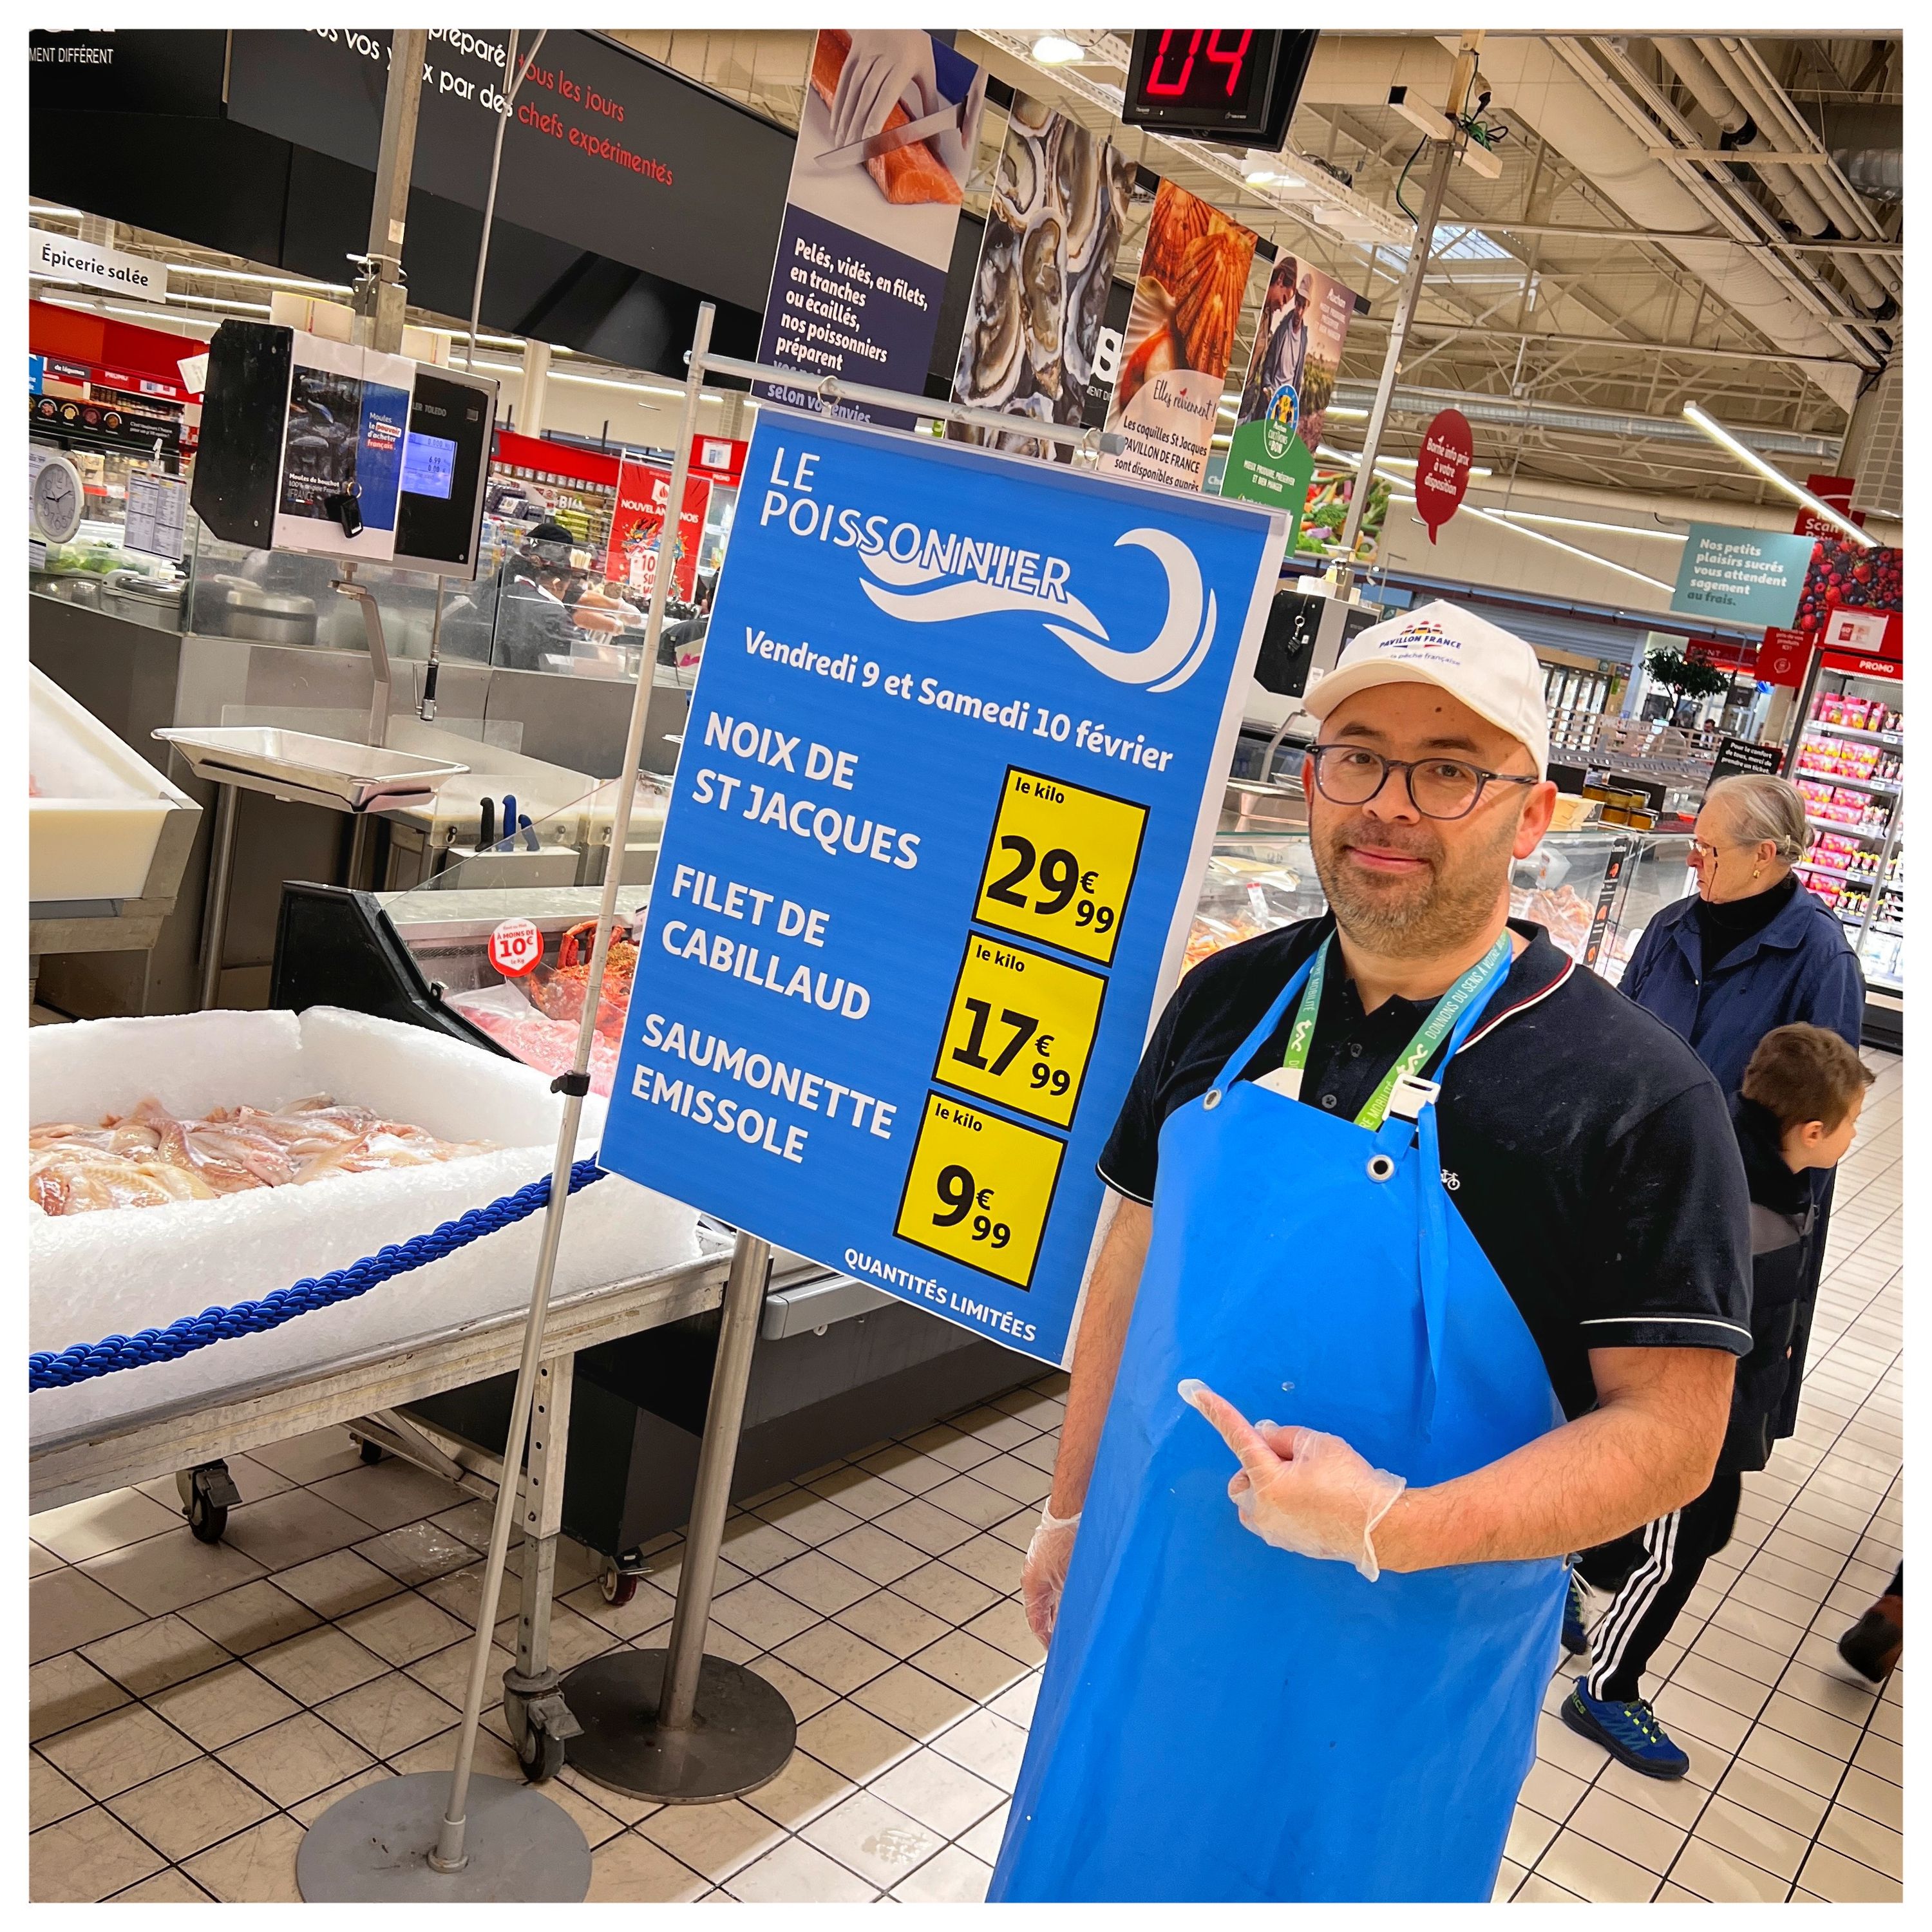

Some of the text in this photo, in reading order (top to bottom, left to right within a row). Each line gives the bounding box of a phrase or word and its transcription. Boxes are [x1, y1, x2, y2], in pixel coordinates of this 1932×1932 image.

[58, 44, 114, 64] DIFFÉRENT
[518, 53, 624, 122] tous les jours
[439, 70, 673, 186] par des chefs expérimentés
[42, 243, 149, 287] Épicerie salée
[795, 237, 928, 311] Pelés, vidés, en filets,
[790, 267, 867, 308] en tranches
[786, 290, 860, 332] ou écaillés,
[775, 337, 843, 371] préparent
[781, 313, 887, 363] nos poissonniers
[425, 404, 447, 417] TOLEDO
[768, 384, 804, 406] selon
[808, 396, 823, 412] vo
[1153, 379, 1171, 408] Elles
[370, 412, 392, 423] Moules
[1123, 415, 1208, 457] Les coquilles St Jacques
[770, 447, 820, 492] LE
[1115, 457, 1132, 473] sont
[1132, 461, 1173, 486] disponibles
[1159, 448, 1170, 463] DE
[1171, 453, 1200, 474] FRANCE
[621, 498, 654, 514] NOUVEL
[680, 512, 699, 523] NOIS
[1805, 518, 1839, 533] Scan
[759, 489, 1071, 603] POISSONNIER
[1696, 553, 1784, 573] plaisirs sucrés
[1700, 538, 1761, 556] Nos petits
[1690, 579, 1750, 595] sagement
[1694, 565, 1787, 587] vous attendent
[1687, 591, 1736, 606] au frais.
[1378, 635, 1462, 649] PAVILLON FRANCE
[1859, 660, 1894, 673] PROMO
[746, 626, 1173, 772] Vendredi 9 et Samedi 10 février
[704, 711, 859, 791] NOIX DE
[1015, 777, 1065, 804] le kilo
[692, 768, 921, 870] ST JACQUES
[986, 835, 1079, 915] 29
[1075, 899, 1115, 933] 99
[671, 864, 830, 947] FILET DE
[500, 938, 526, 958] 10
[504, 931, 525, 939] MOINS
[662, 920, 871, 1019] CABILLAUD
[976, 945, 1025, 973] le kilo
[1425, 1001, 1459, 1039] DONNONS
[1452, 989, 1468, 1004] DU
[1461, 971, 1484, 992] SENS
[951, 997, 1039, 1077] 17
[1030, 1063, 1070, 1096] 99
[641, 1013, 897, 1140] SAUMONETTE
[631, 1064, 808, 1164] EMISSOLE
[935, 1103, 983, 1132] le kilo
[932, 1164, 976, 1227] 9
[971, 1215, 1011, 1249] 99
[844, 1247, 1037, 1342] QUANTITÉS LIMITÉES
